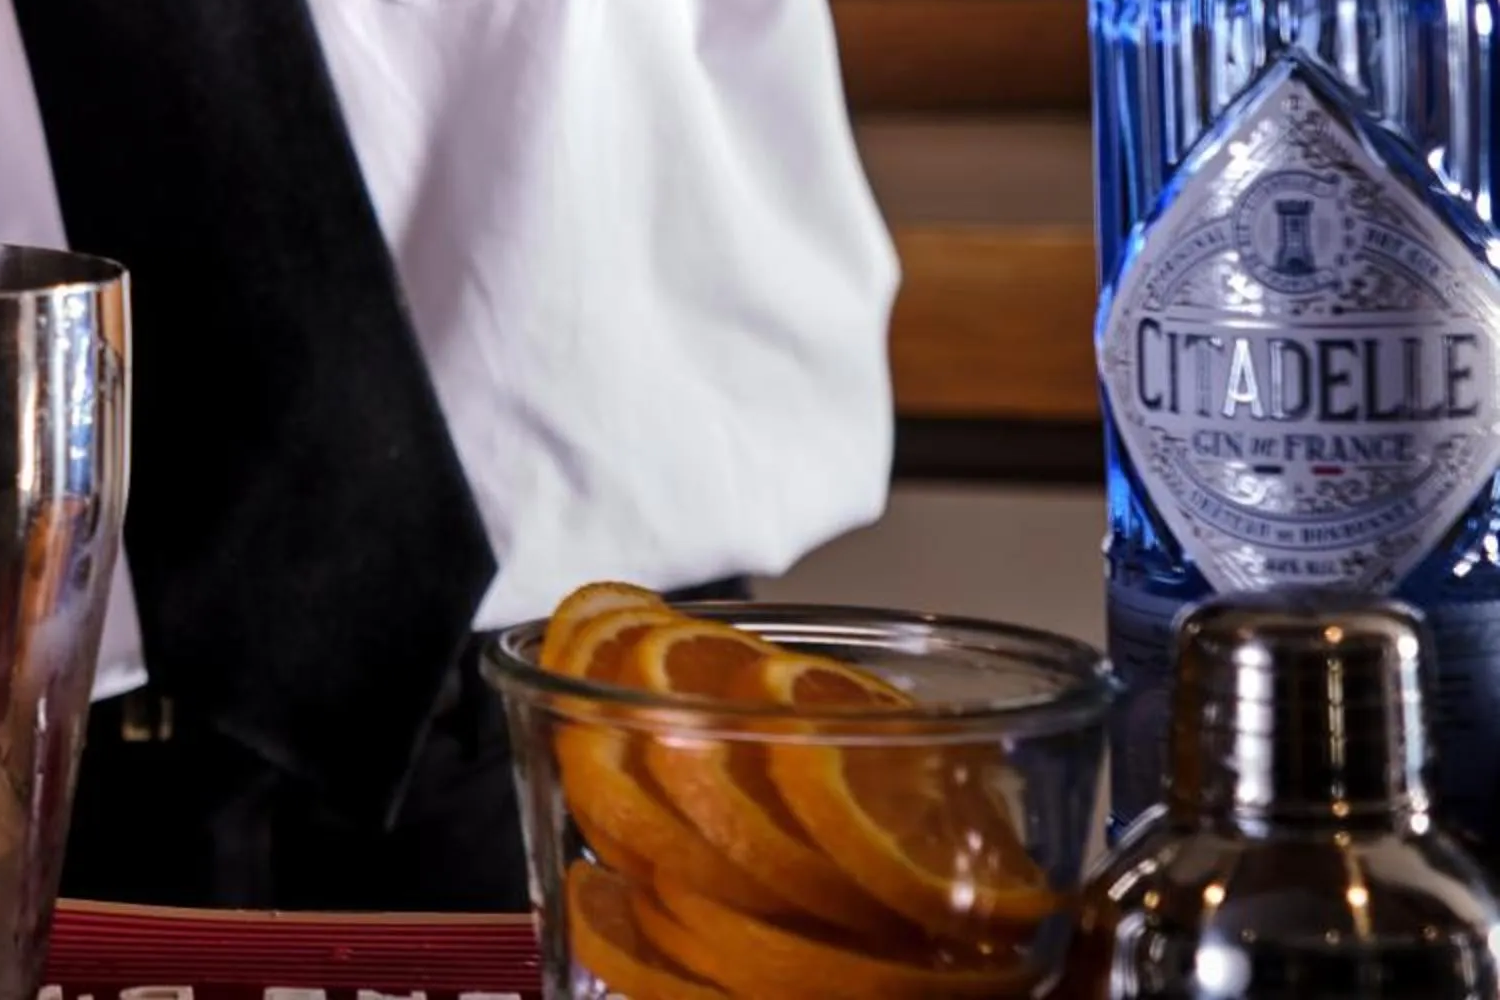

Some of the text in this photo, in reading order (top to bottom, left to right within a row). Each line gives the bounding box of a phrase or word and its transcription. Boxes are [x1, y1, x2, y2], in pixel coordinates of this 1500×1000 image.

[1135, 317, 1479, 422] CITADELLE
[1193, 430, 1244, 458] GIN
[1284, 433, 1414, 462] FRANCE
